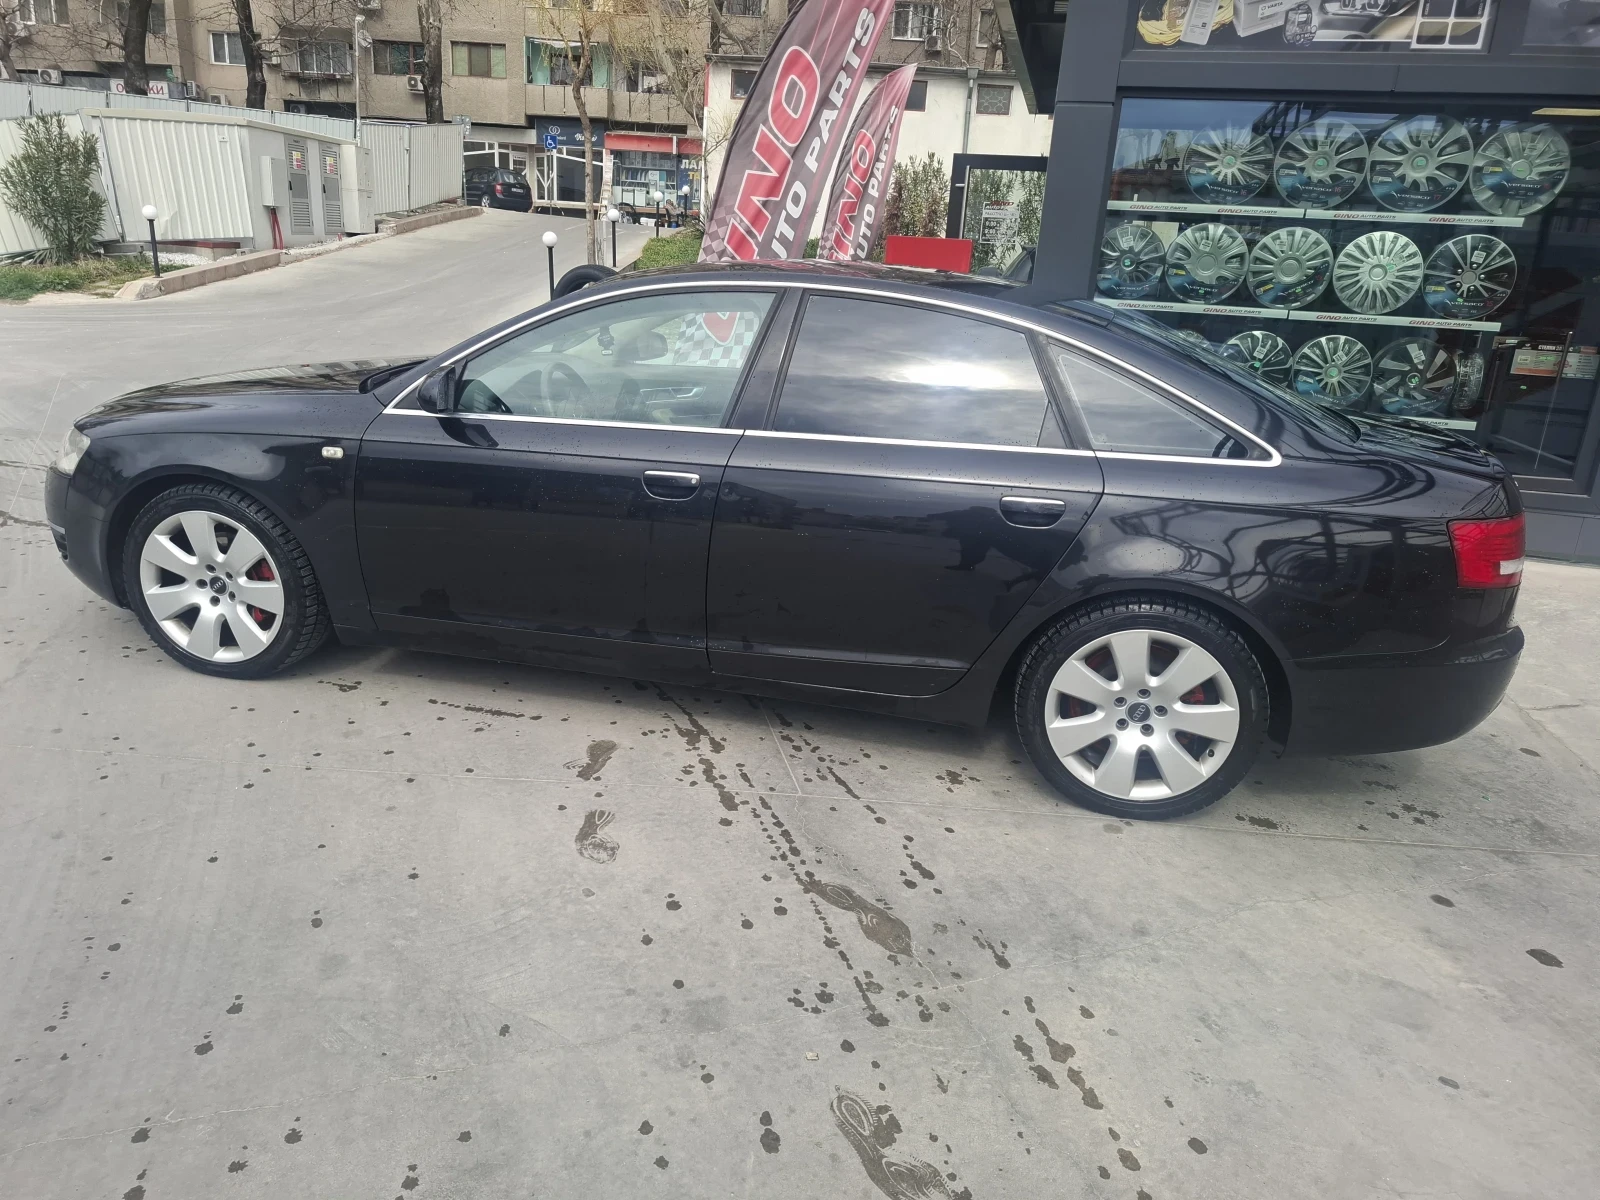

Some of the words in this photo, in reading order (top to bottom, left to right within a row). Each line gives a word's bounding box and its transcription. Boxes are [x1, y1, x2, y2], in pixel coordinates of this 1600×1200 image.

[724, 45, 820, 260] INO
[771, 180, 807, 259] UTO
[804, 7, 876, 173] PARTS
[856, 203, 876, 259] UTO
[867, 105, 898, 198] PARTS
